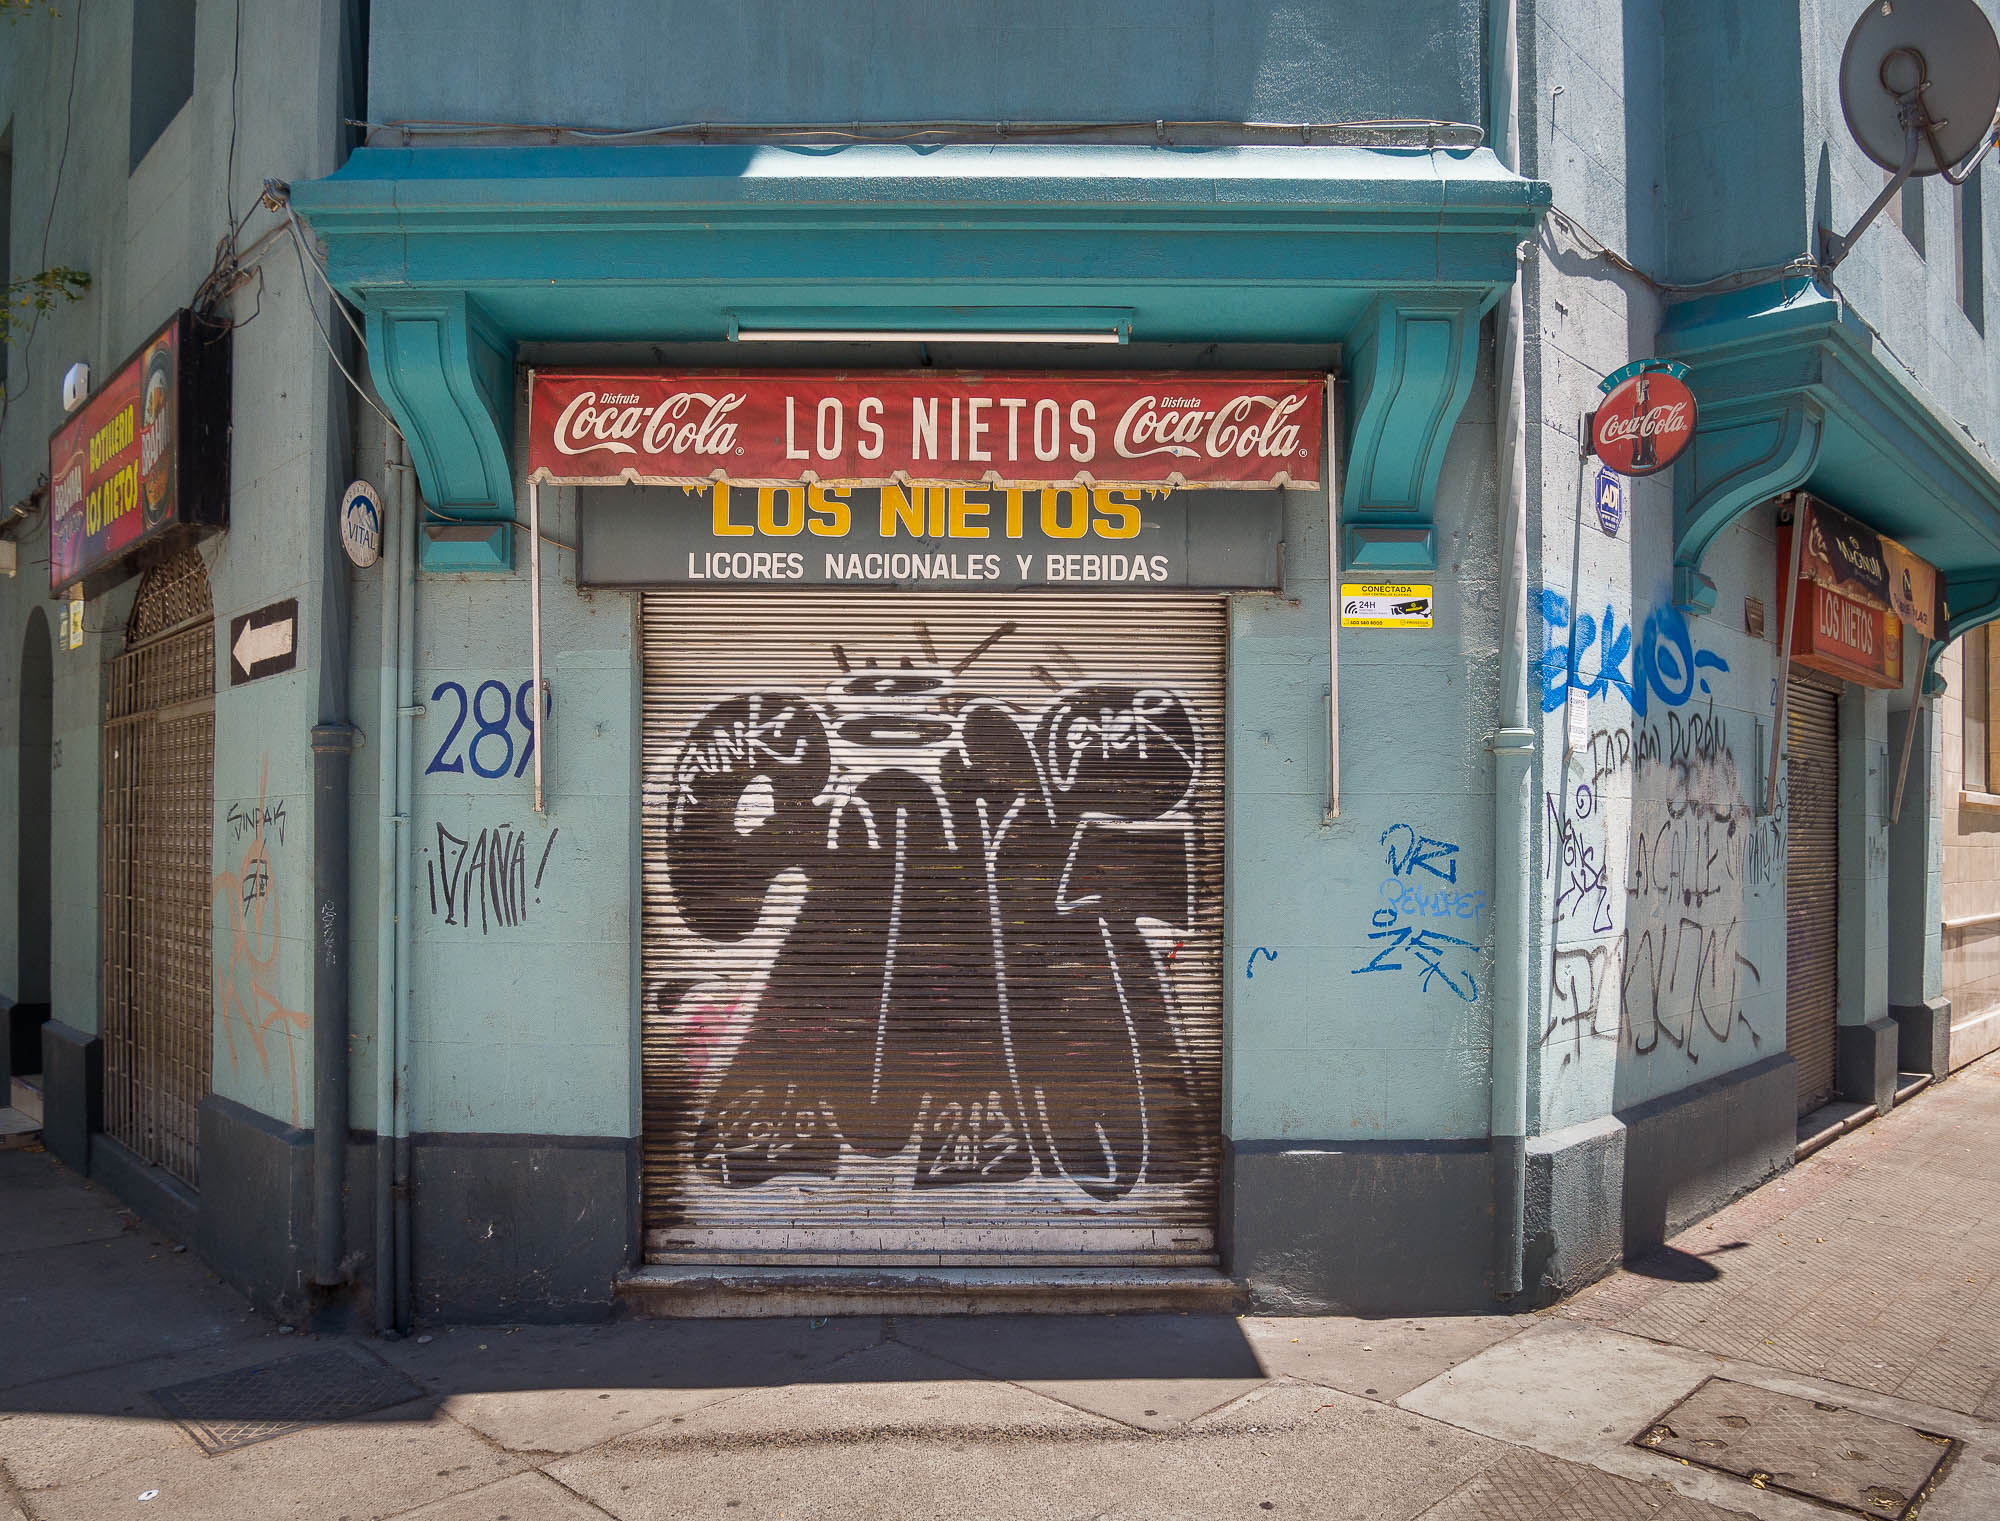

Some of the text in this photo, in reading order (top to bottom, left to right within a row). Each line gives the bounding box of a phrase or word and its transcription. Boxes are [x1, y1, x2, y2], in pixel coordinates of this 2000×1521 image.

[600, 392, 640, 405] Disfruta
[1160, 396, 1201, 409] Disfruta
[553, 391, 747, 455] Coca-Cola
[785, 396, 1096, 462] LOS NIETOS
[1113, 394, 1308, 459] Coca-Cola
[1600, 402, 1688, 445] Coca-Cola
[86, 486, 102, 537] LOS
[104, 458, 138, 527] NIETOS
[348, 520, 376, 550] VITAL
[688, 552, 1169, 582] LICORES NACIONALES Y BEBIDAS
[1835, 536, 1882, 581] MAGNUM
[1359, 601, 1376, 609] 24H
[1361, 585, 1412, 593] CONECTADA
[1820, 588, 1840, 641] LOS
[1841, 598, 1873, 656] NIETOS
